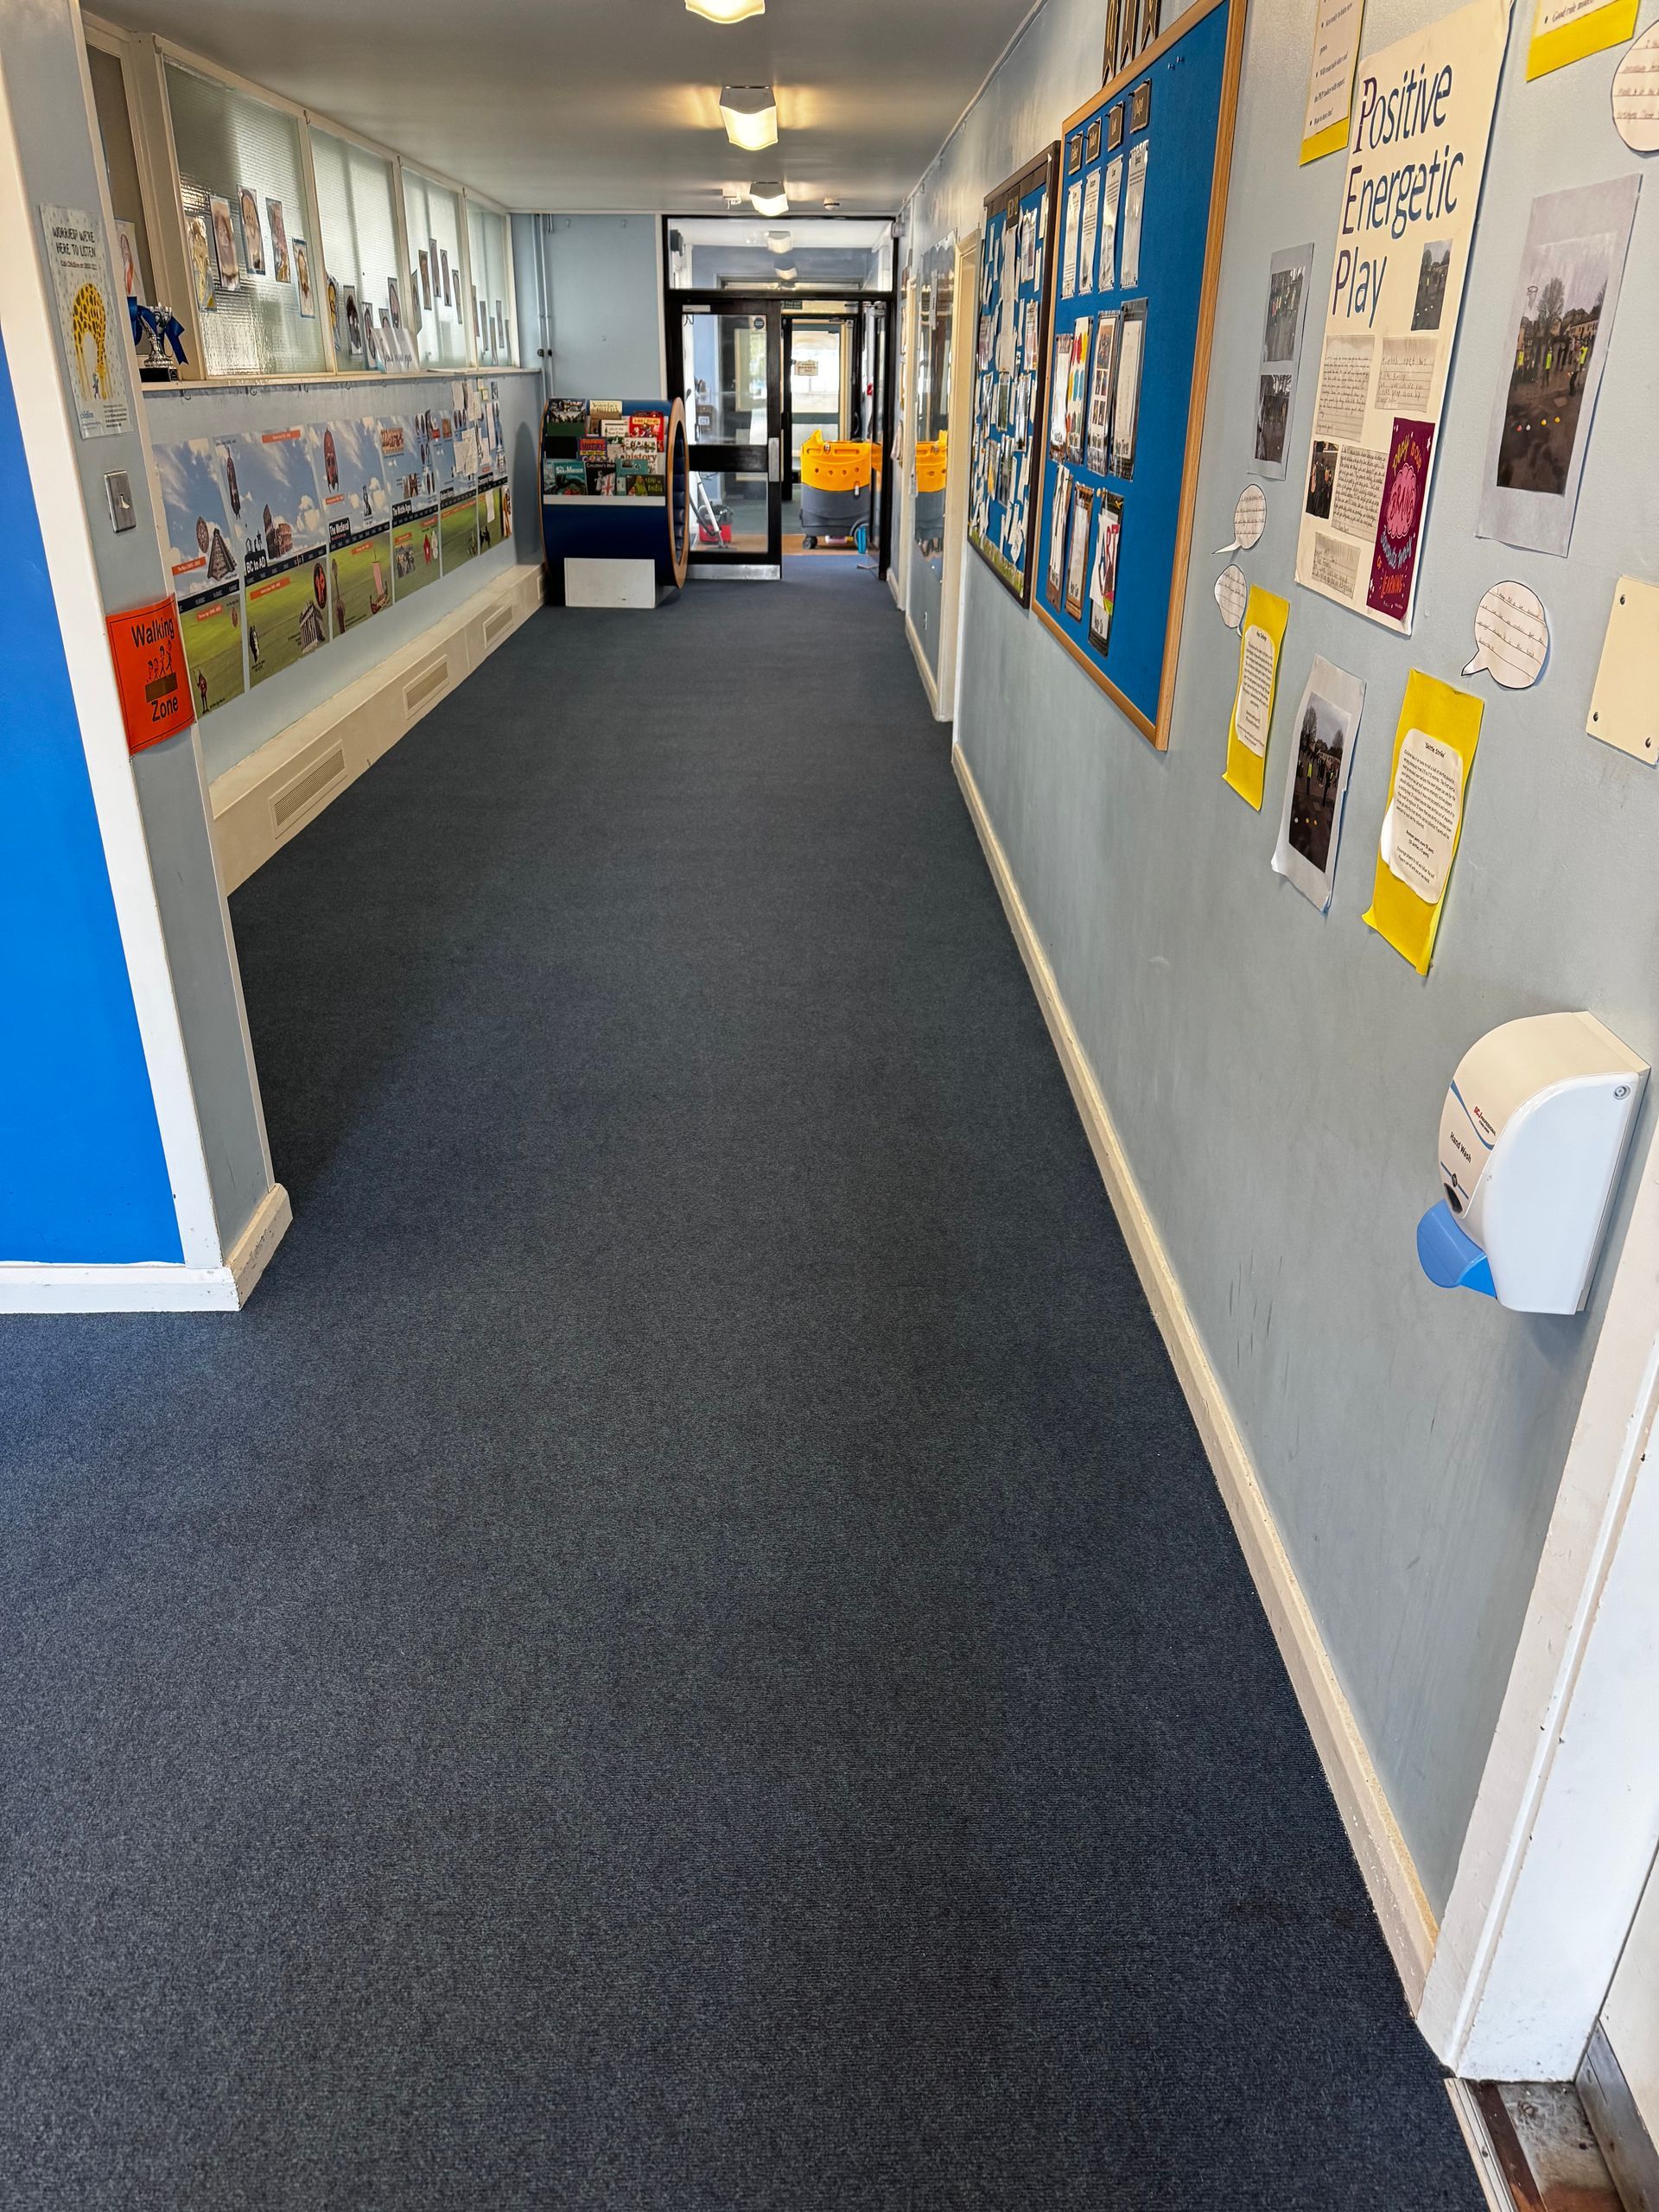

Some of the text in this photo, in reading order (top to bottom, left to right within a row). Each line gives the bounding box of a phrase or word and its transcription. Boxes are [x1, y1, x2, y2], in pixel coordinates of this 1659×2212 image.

[1352, 63, 1452, 154] Positive
[1342, 144, 1464, 239] Energetic
[1332, 247, 1388, 328] Play
[245, 561, 254, 574] BC
[259, 556, 267, 569] AD
[131, 618, 175, 648] Walking
[151, 696, 179, 722] Zone
[1450, 1132, 1471, 1163] Hand Wash
